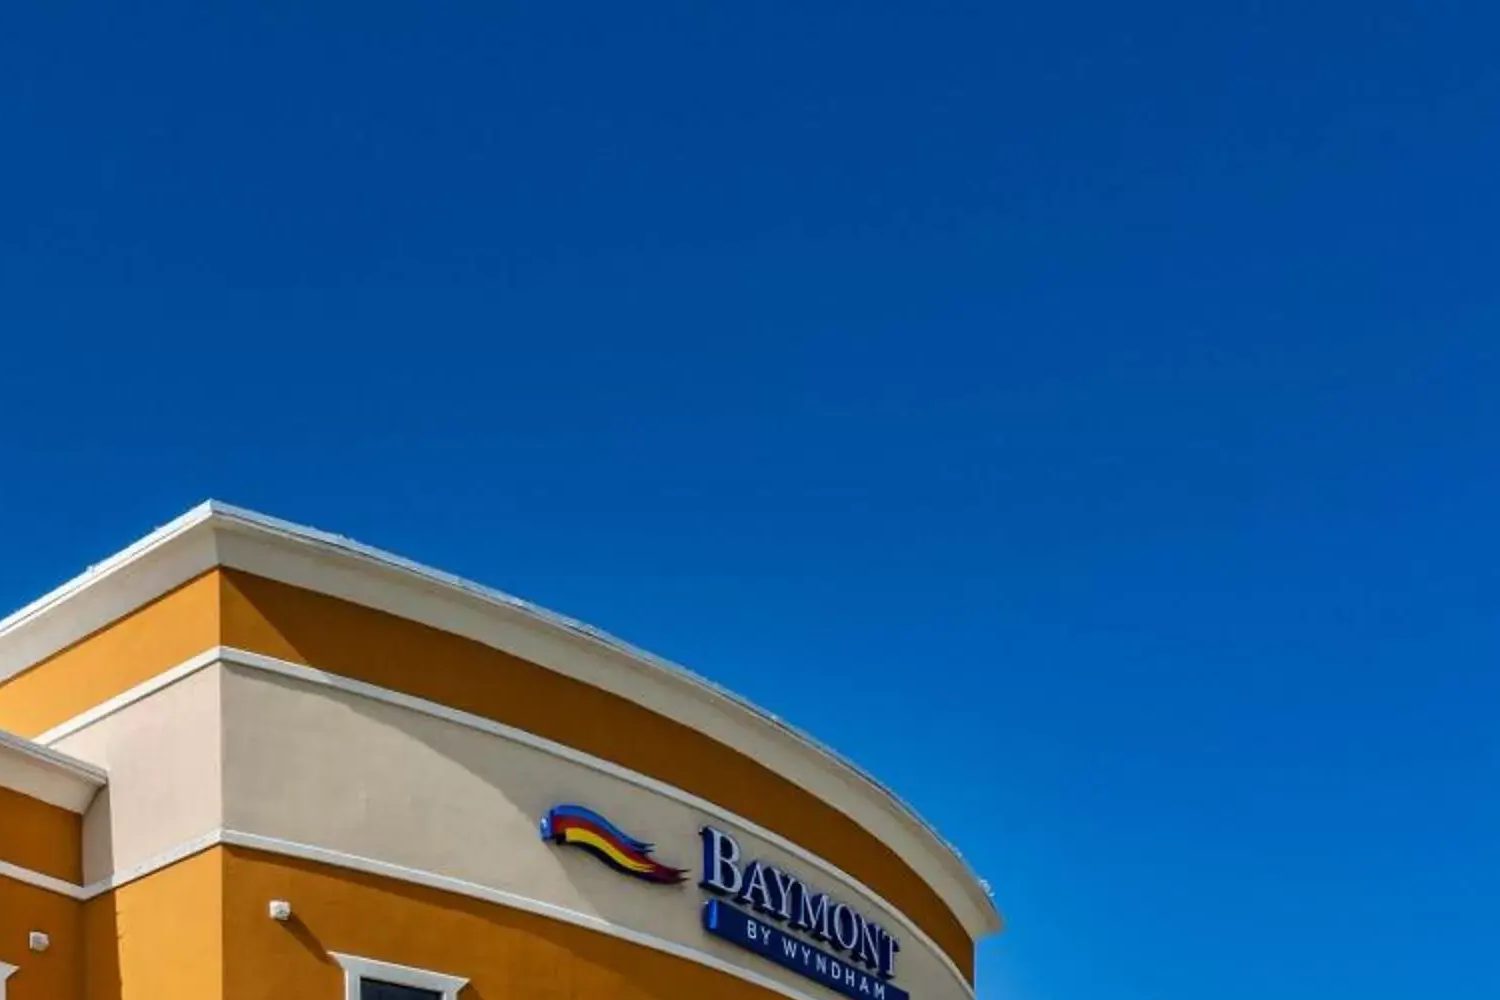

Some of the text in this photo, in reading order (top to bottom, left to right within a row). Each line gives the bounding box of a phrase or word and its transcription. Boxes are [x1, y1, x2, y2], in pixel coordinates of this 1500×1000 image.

[703, 826, 899, 977] BAYMONT
[746, 919, 886, 1000] BY WYNDHAM
